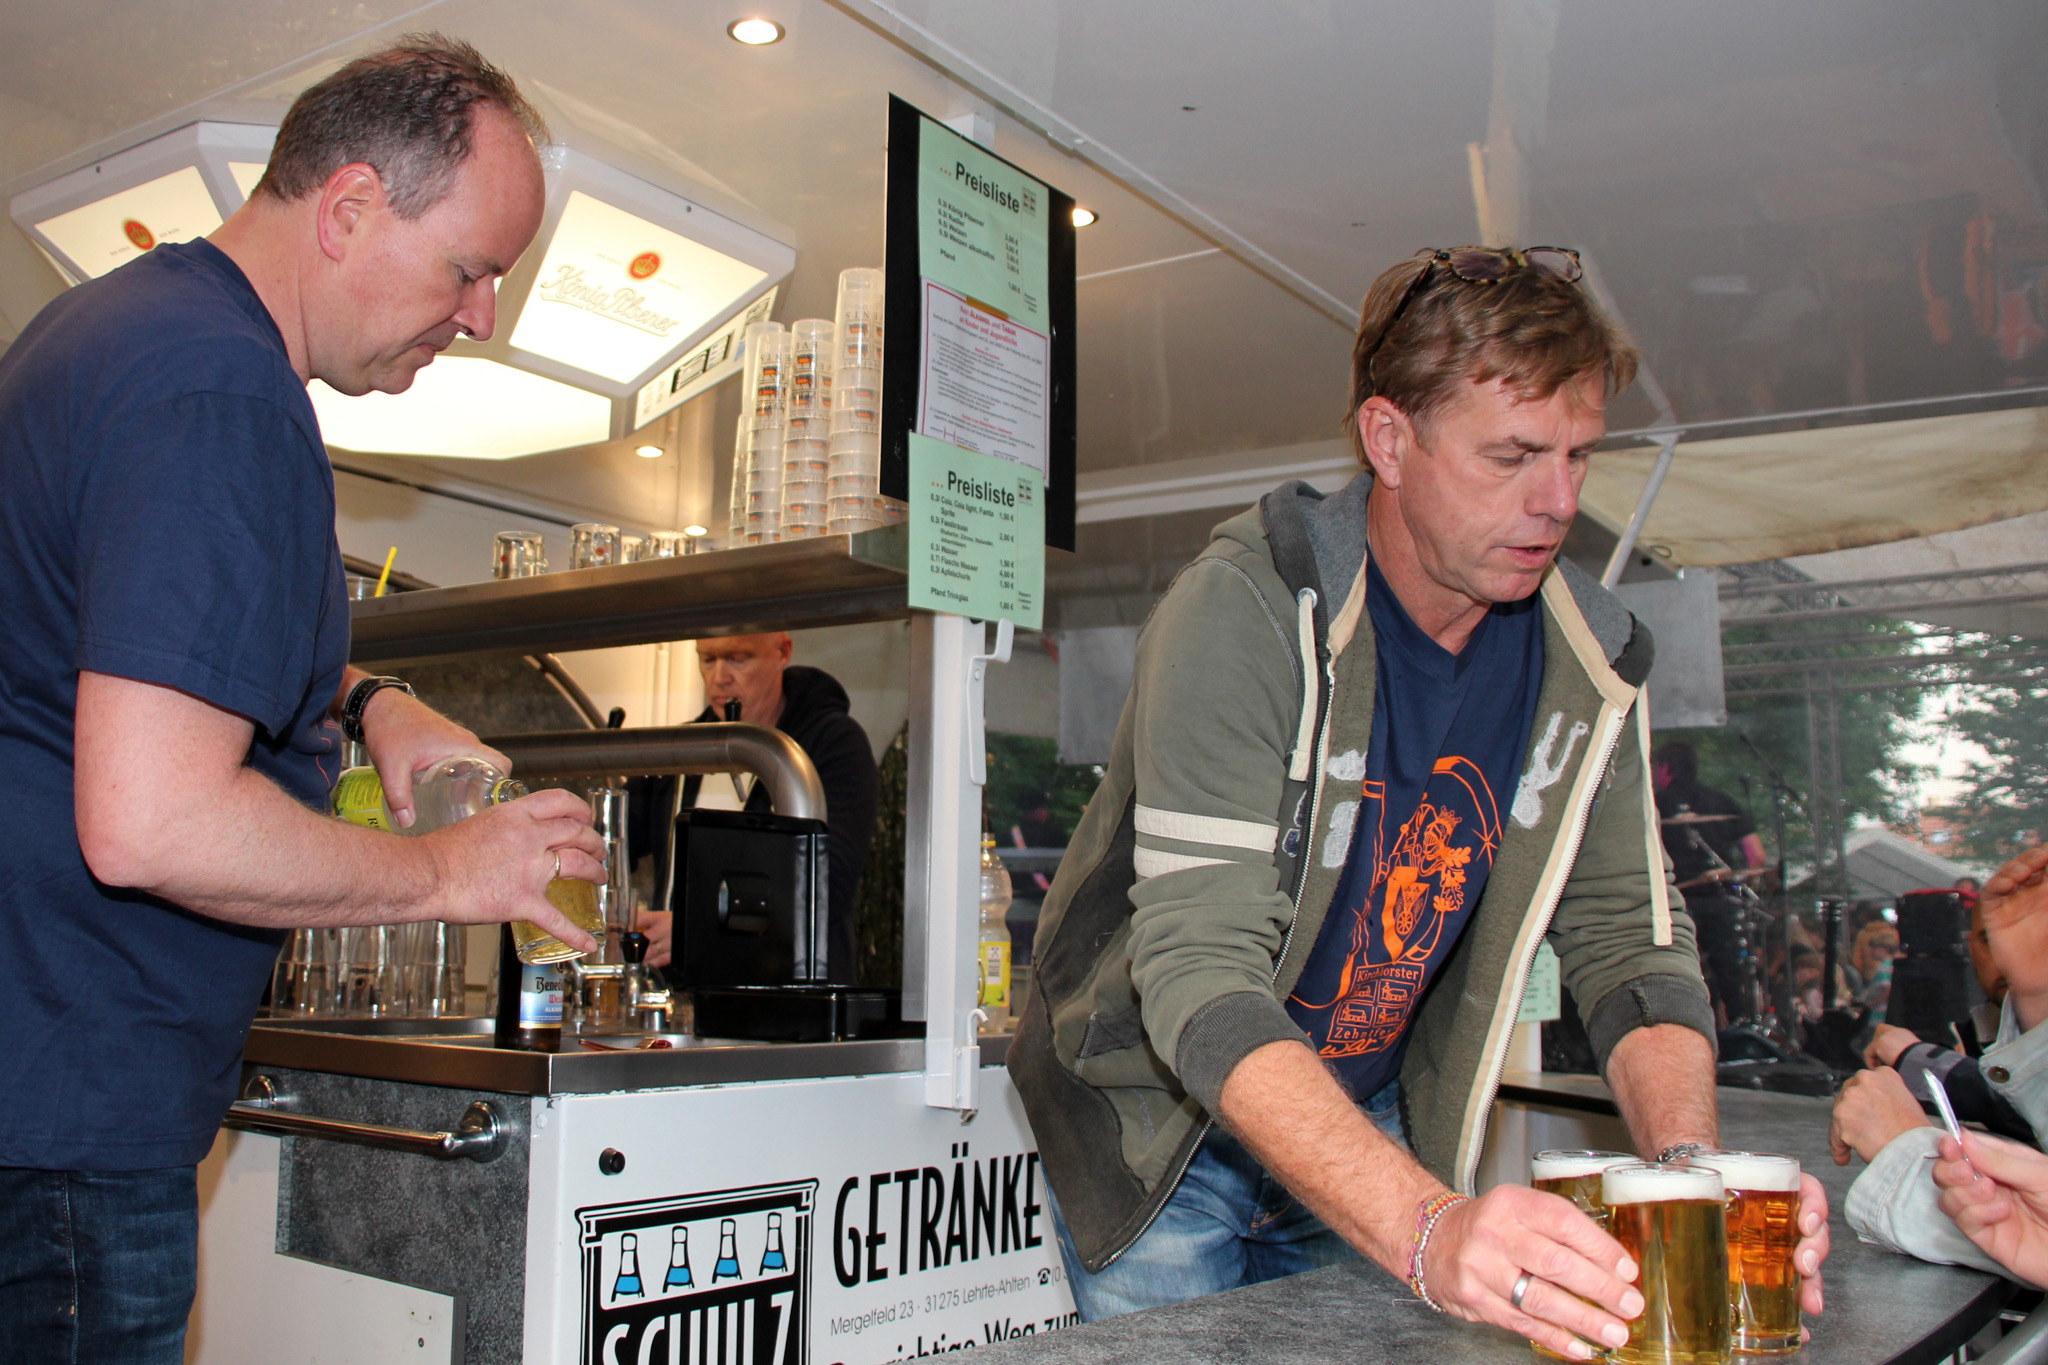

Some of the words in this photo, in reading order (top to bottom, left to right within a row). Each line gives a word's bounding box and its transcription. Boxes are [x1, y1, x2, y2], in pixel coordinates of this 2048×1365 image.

[956, 161, 1020, 214] Preisliste
[940, 248, 956, 262] Pfand
[540, 264, 611, 311] König
[601, 287, 680, 332] Pilsener
[948, 470, 1015, 508] Preisliste
[979, 506, 994, 518] Fanta
[941, 546, 958, 556] Wasser
[941, 557, 960, 568] Flasche
[960, 560, 978, 572] Wasser
[930, 586, 946, 598] Pfand
[947, 590, 968, 602] Trinkglas
[833, 1141, 1043, 1288] GETRÄNKE
[830, 1304, 896, 1336] Mergelfeld
[899, 1300, 914, 1320] 23
[924, 1289, 960, 1314] 31275
[963, 1274, 1031, 1304] Lehrte-Ahlten
